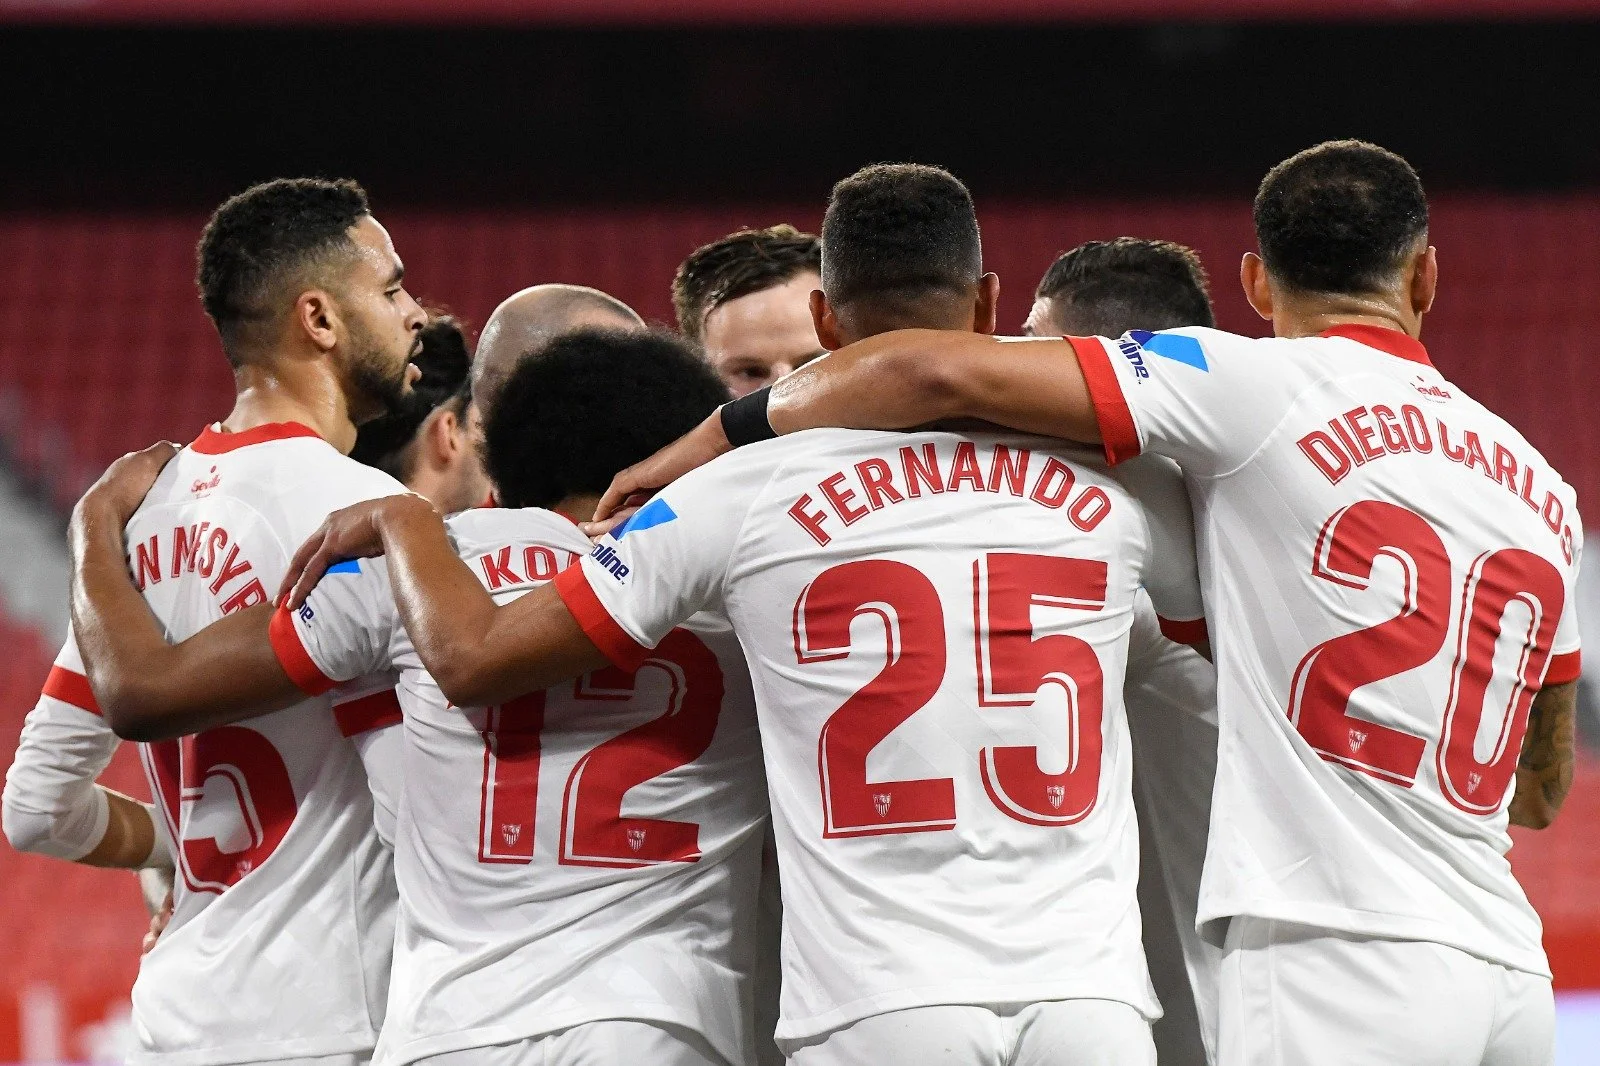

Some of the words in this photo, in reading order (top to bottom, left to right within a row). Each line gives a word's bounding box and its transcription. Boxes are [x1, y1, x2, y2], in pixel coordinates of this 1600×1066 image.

[788, 442, 1112, 547] FERNANDO
[1296, 404, 1433, 486] DIEGO
[1436, 417, 1572, 566] CARLOS
[477, 627, 725, 870] 12
[793, 553, 1108, 840] 25
[1289, 500, 1565, 816] 20
